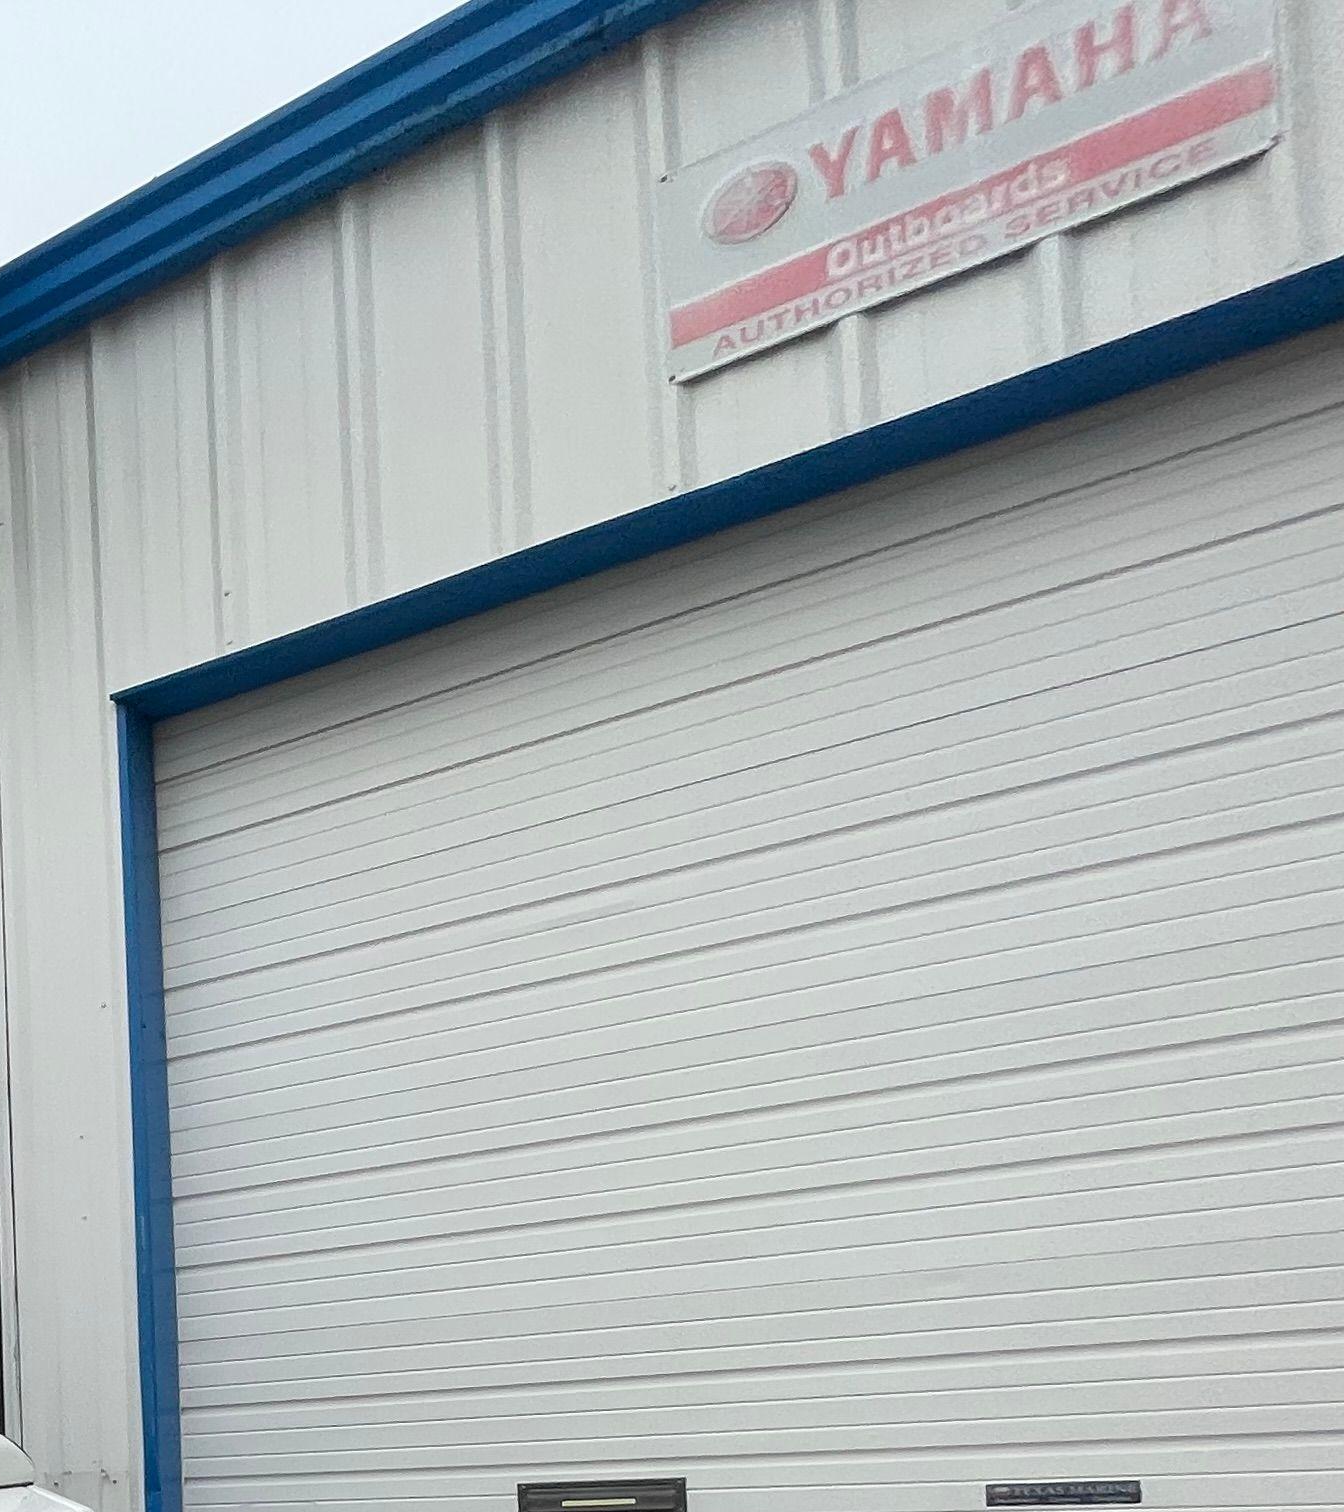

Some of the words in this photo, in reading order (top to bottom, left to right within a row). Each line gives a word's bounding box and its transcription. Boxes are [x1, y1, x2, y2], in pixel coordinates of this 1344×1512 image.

[809, 0, 1210, 198] YAMAHA
[713, 234, 988, 355] AUTHORIZED
[1004, 139, 1215, 237] SERVICE
[825, 164, 1070, 275] Outboards
